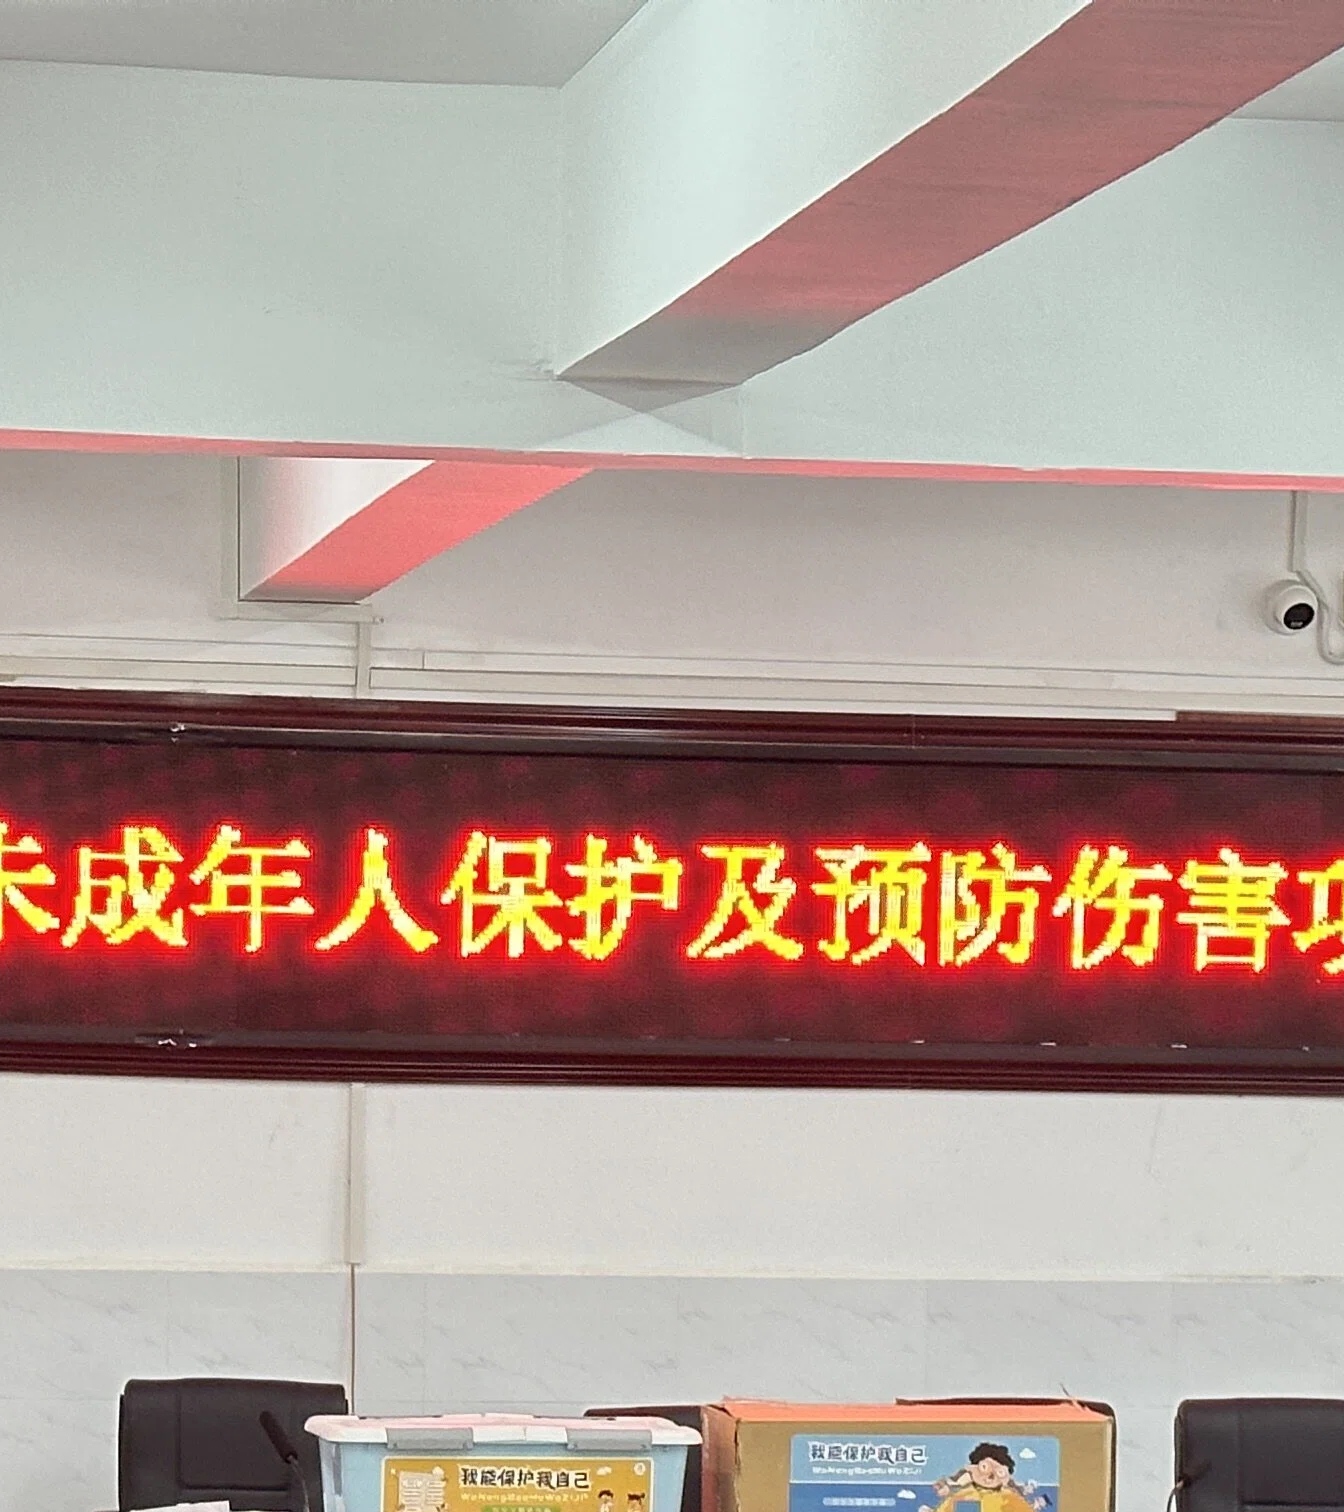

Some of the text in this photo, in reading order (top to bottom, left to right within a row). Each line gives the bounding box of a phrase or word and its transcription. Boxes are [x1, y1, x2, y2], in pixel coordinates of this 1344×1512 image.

[460, 1466, 591, 1490] 我能保护我自己
